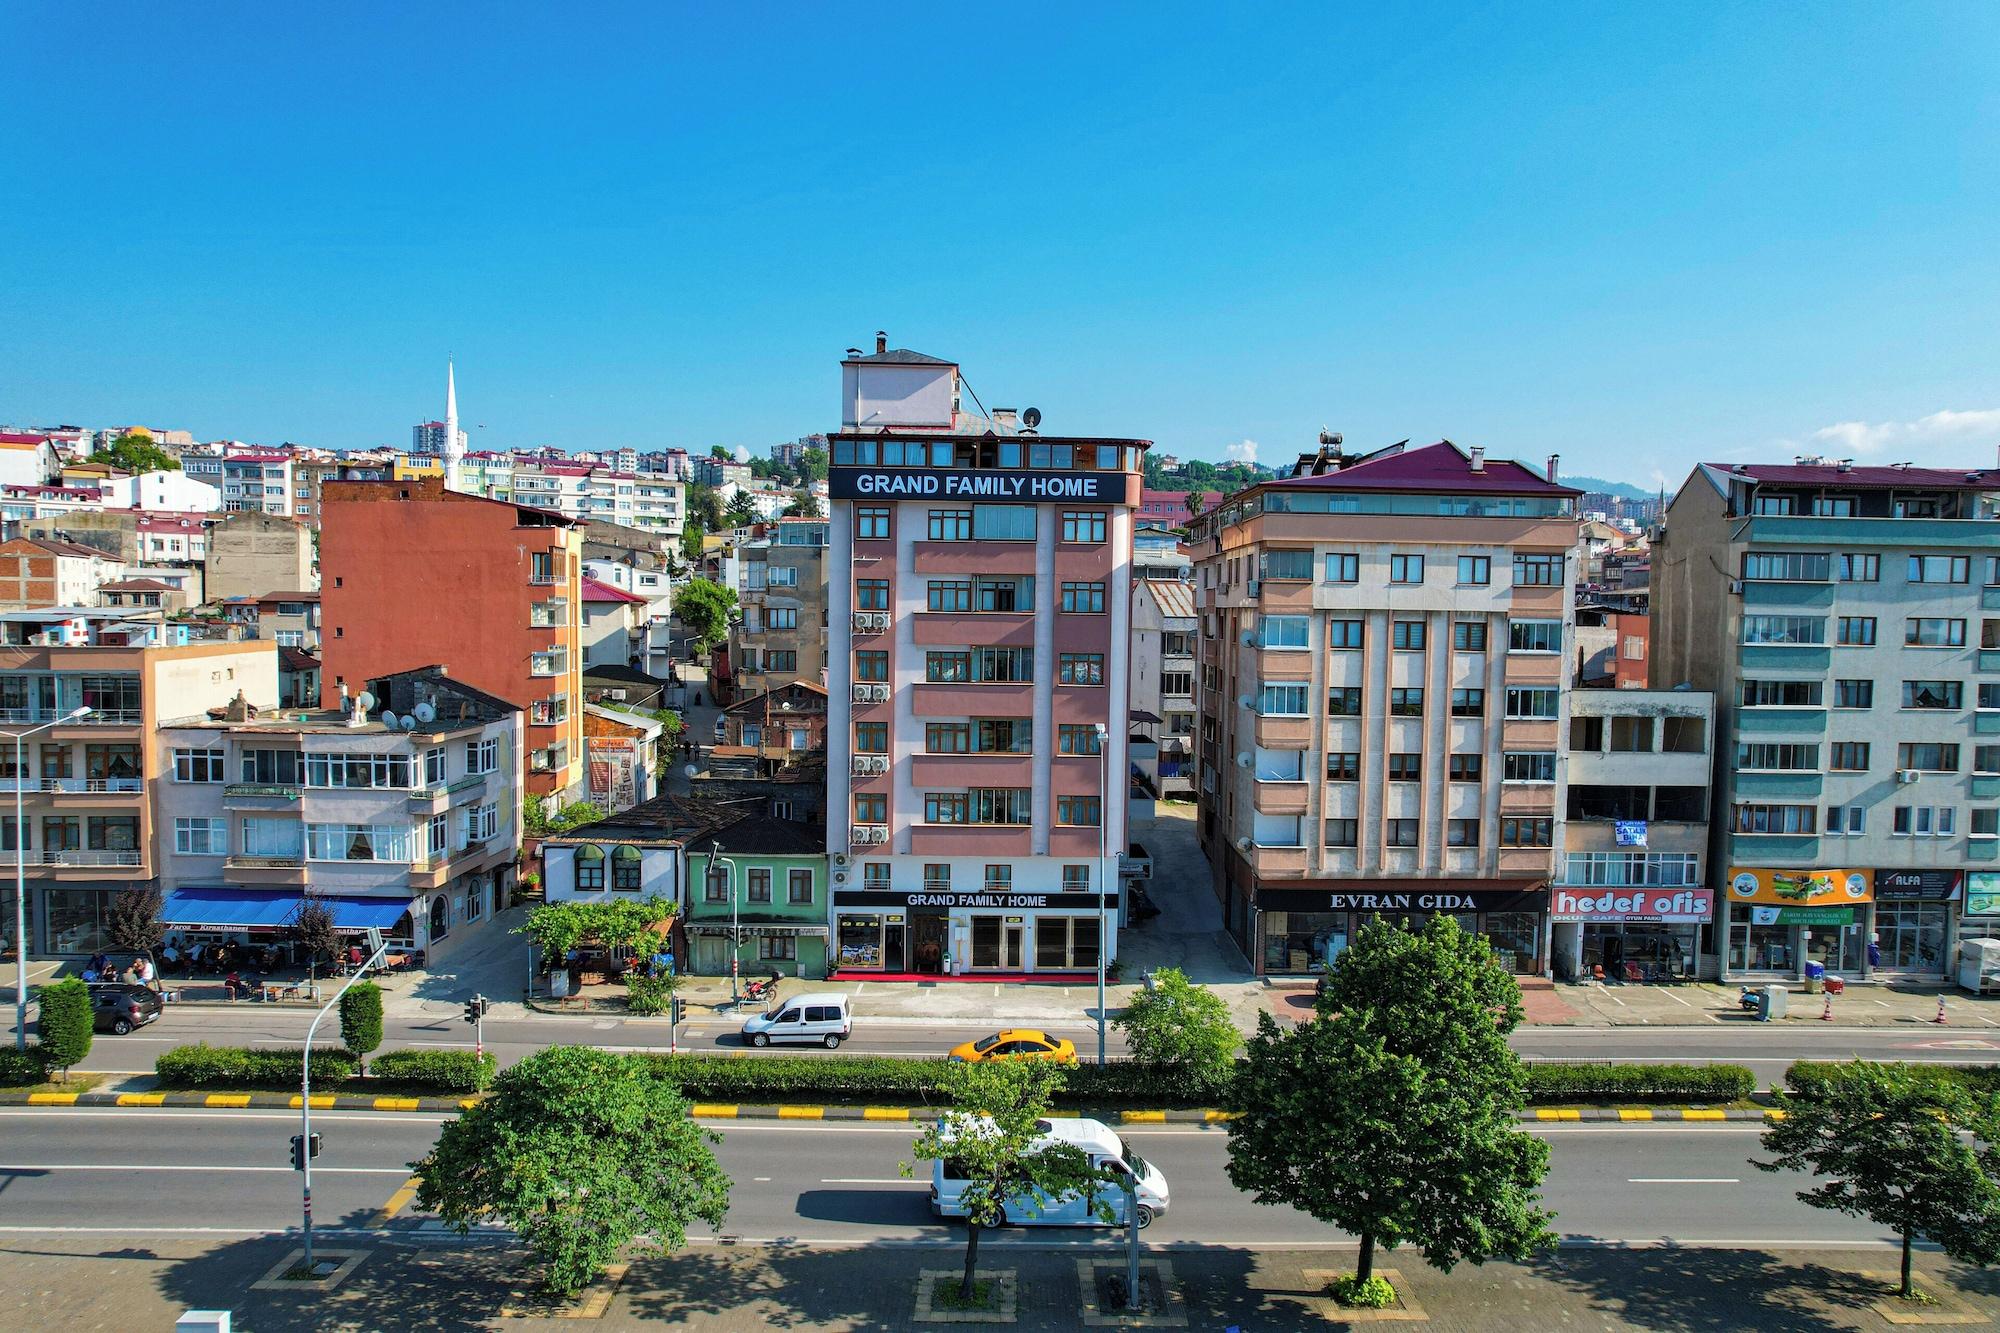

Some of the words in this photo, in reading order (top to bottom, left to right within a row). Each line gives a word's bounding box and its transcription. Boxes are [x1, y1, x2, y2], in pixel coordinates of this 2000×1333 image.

[856, 474, 938, 494] GRAND
[945, 475, 1026, 496] FAMILY
[1031, 478, 1098, 497] HOME
[1895, 875, 1920, 885] ALFA
[907, 894, 955, 906] GRAND
[958, 895, 1005, 907] FAMILY
[1008, 895, 1047, 907] HOME
[1330, 894, 1411, 908] EVRAN
[1418, 894, 1477, 909] GIDA
[1557, 891, 1646, 913] hedef
[1654, 891, 1707, 913] ofis
